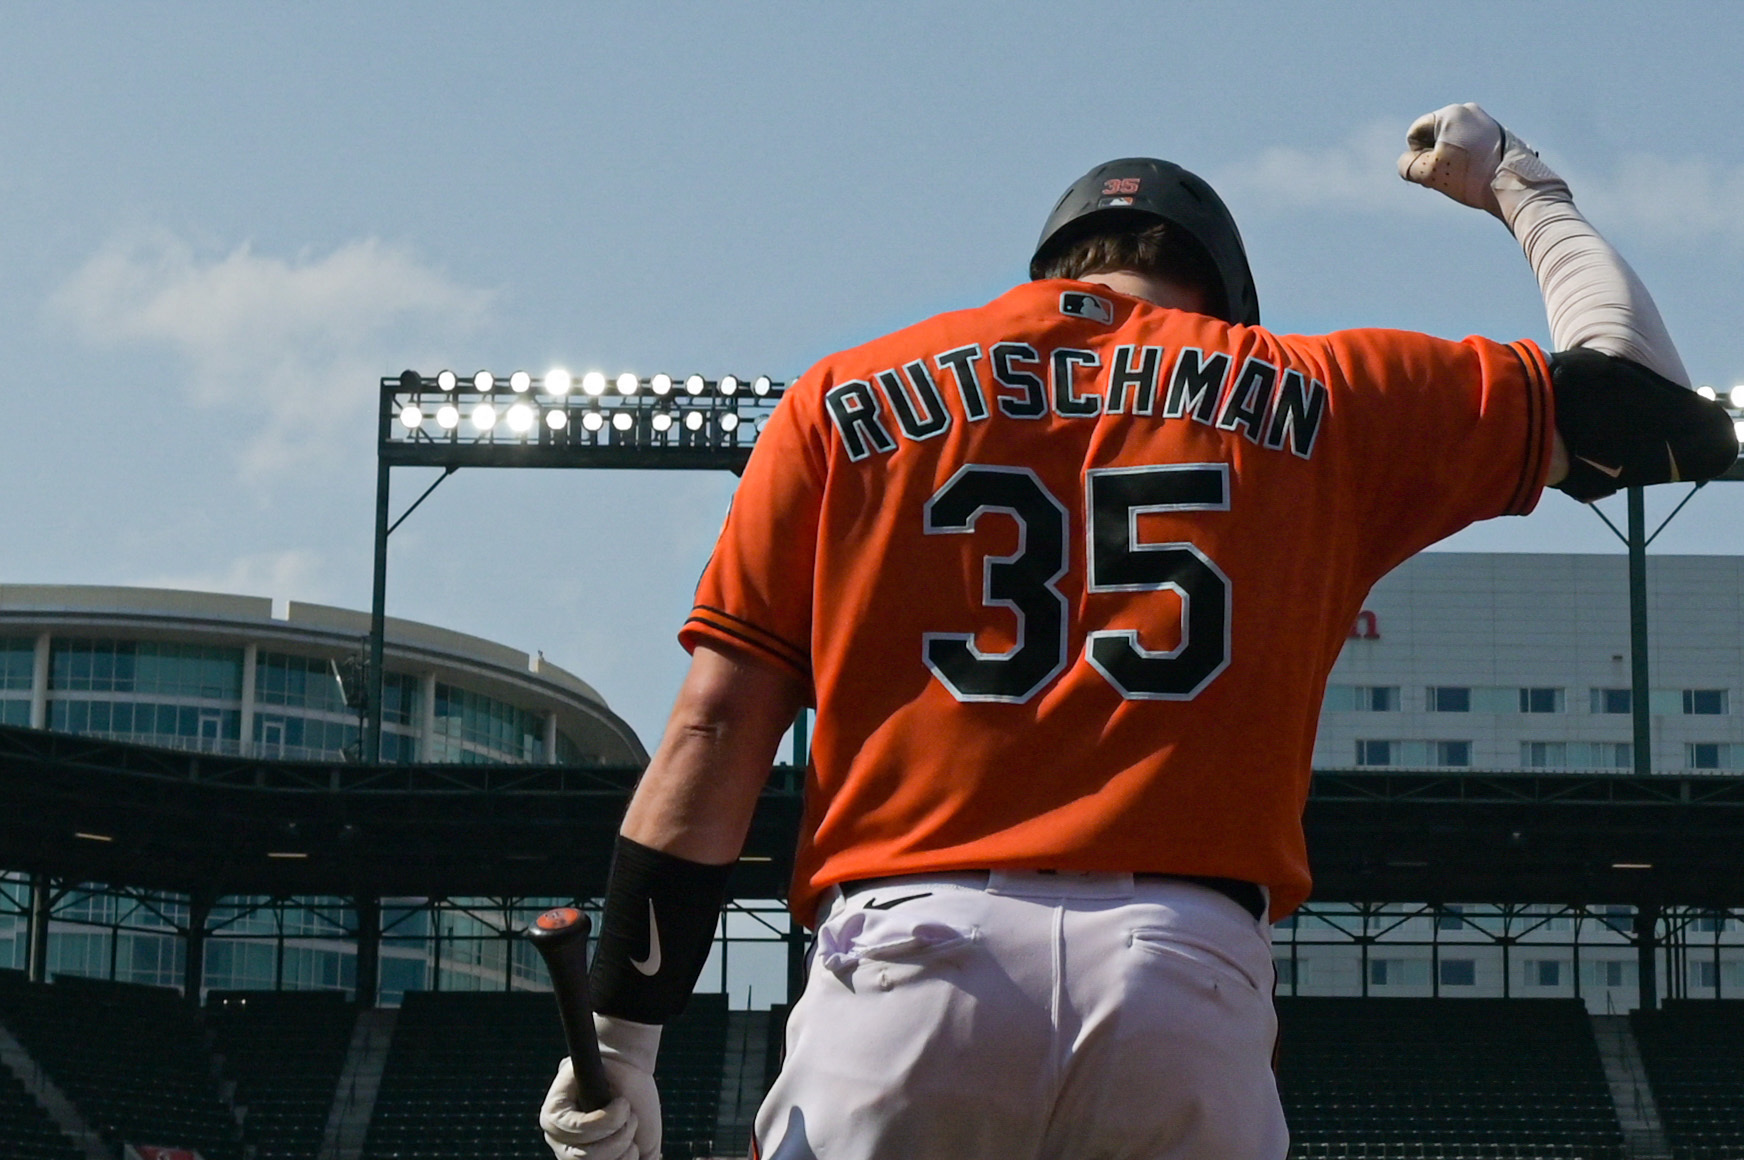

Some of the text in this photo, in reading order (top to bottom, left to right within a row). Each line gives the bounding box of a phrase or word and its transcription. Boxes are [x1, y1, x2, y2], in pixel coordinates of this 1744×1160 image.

[1102, 178, 1141, 195] 35
[826, 342, 1328, 462] RUTSCHMAN
[923, 463, 1232, 704] 35
